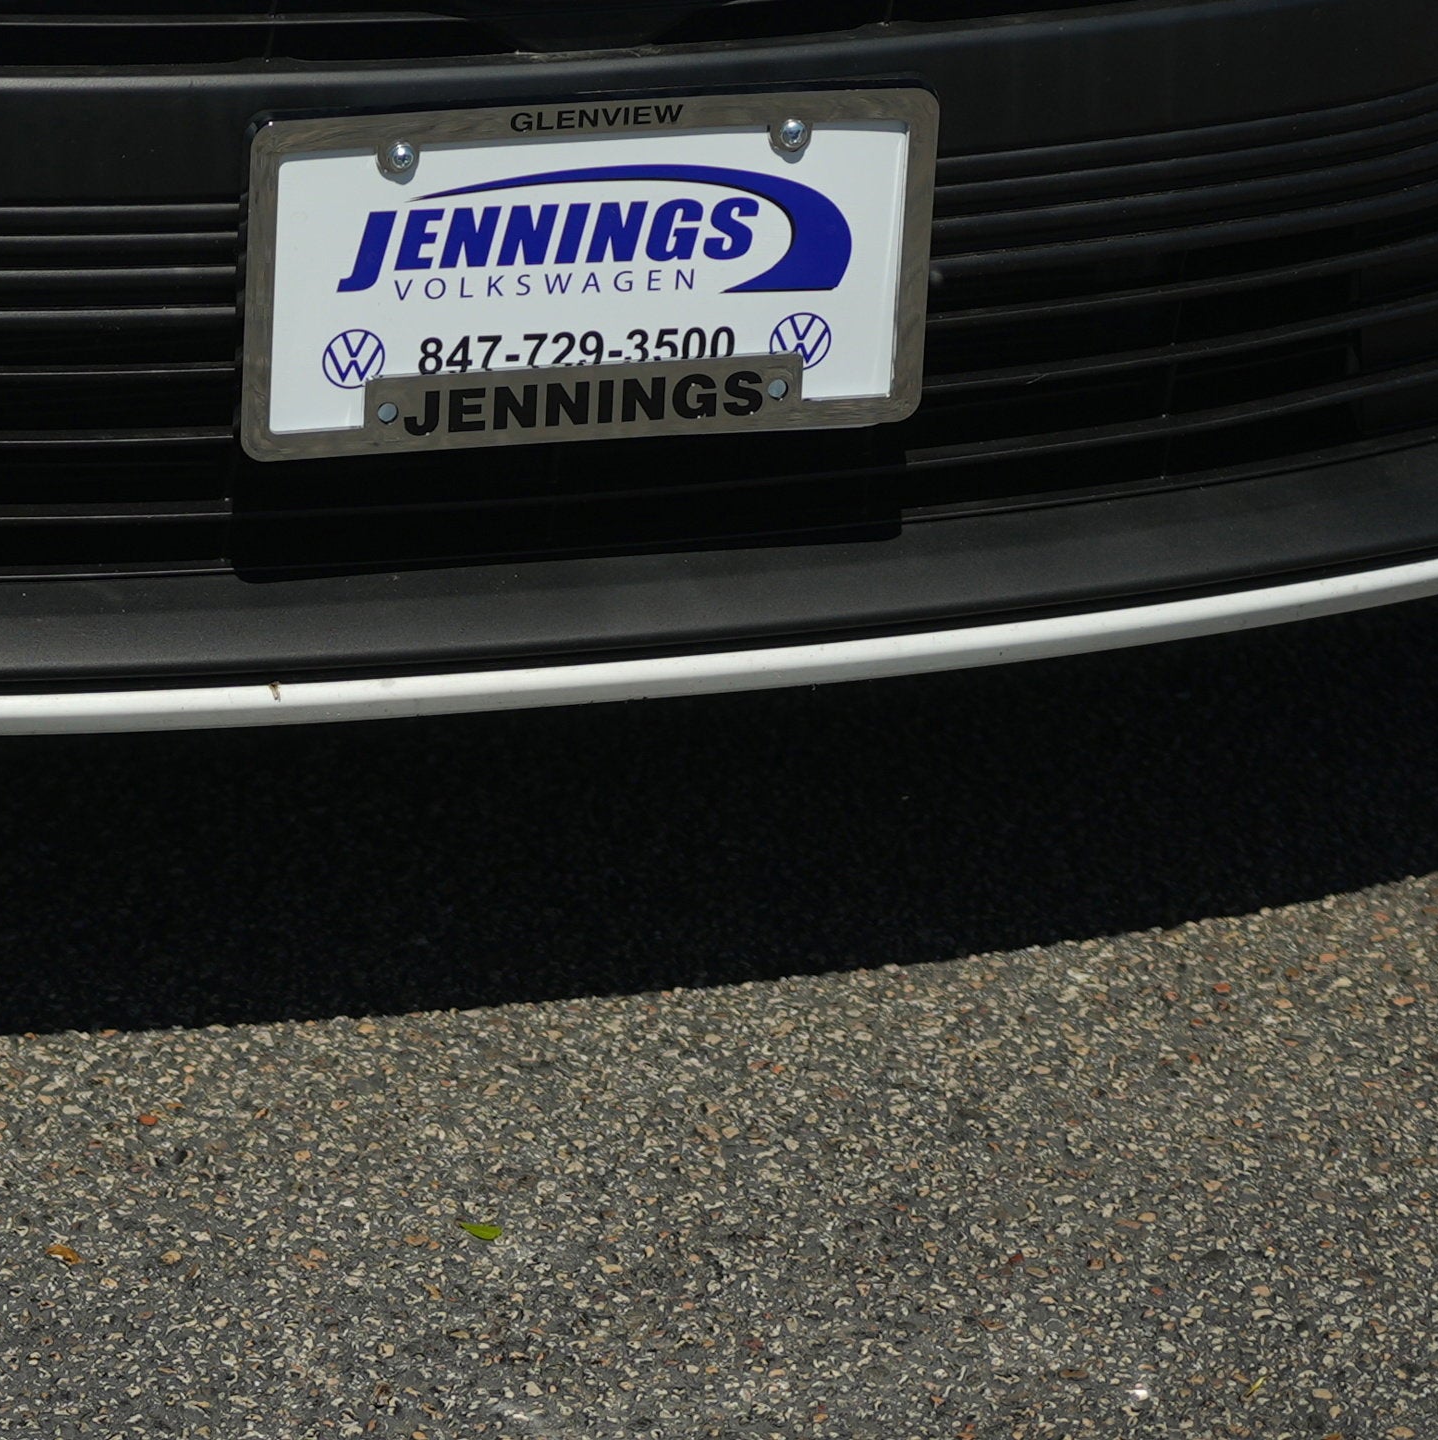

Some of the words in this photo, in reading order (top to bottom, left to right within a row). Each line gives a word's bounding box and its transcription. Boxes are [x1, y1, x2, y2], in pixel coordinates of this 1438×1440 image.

[510, 103, 685, 133] GLENVIEW
[335, 196, 760, 294] JENNINGS
[393, 268, 696, 301] VOLKSWAGEN
[417, 325, 736, 375] 847-729-3500
[403, 370, 763, 437] JENNINGS
